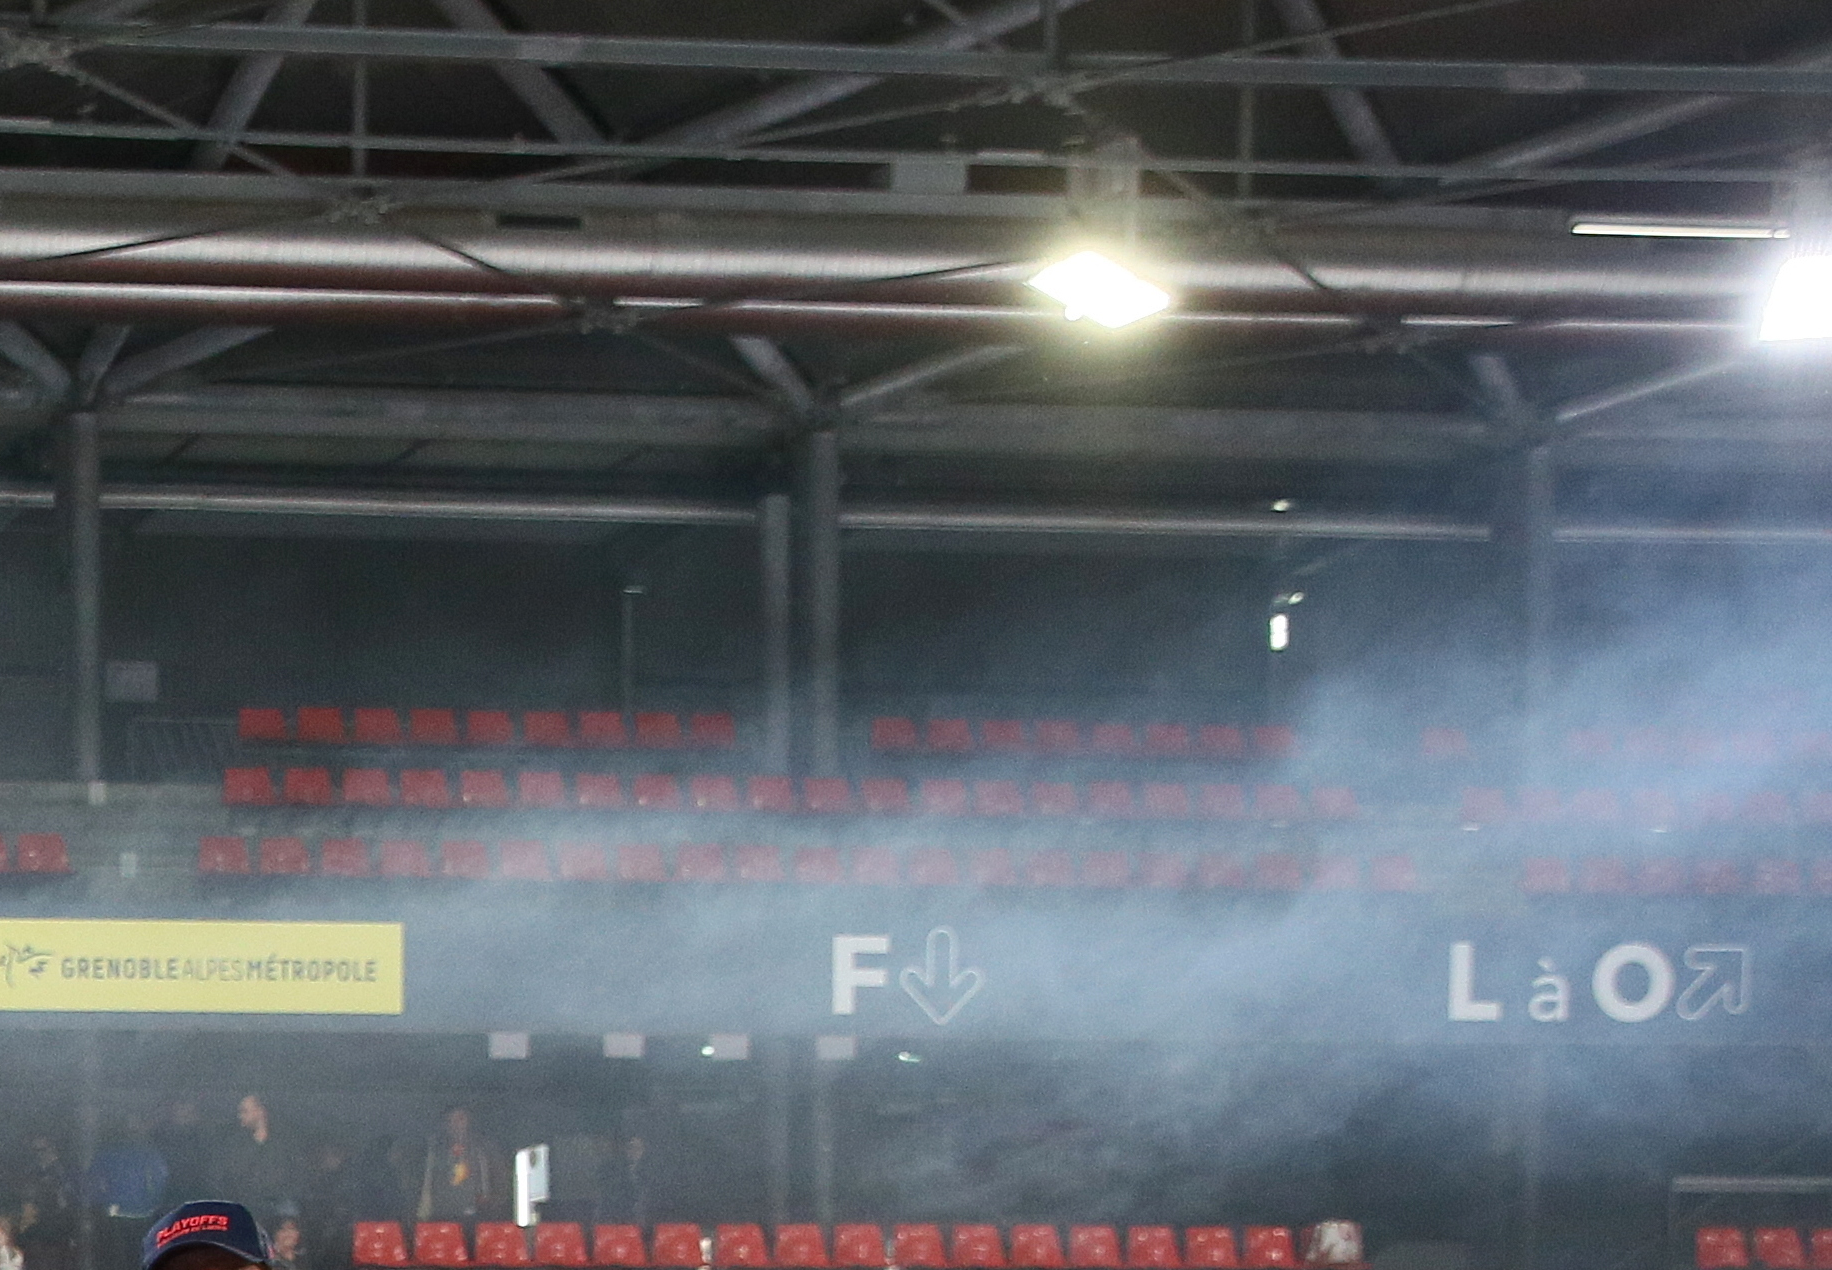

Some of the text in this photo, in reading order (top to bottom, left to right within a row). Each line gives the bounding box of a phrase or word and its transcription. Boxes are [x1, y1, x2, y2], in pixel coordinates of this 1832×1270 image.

[833, 934, 891, 1014] F
[1450, 940, 1674, 1022] L à O
[157, 1214, 228, 1241] PLAYOFFS
